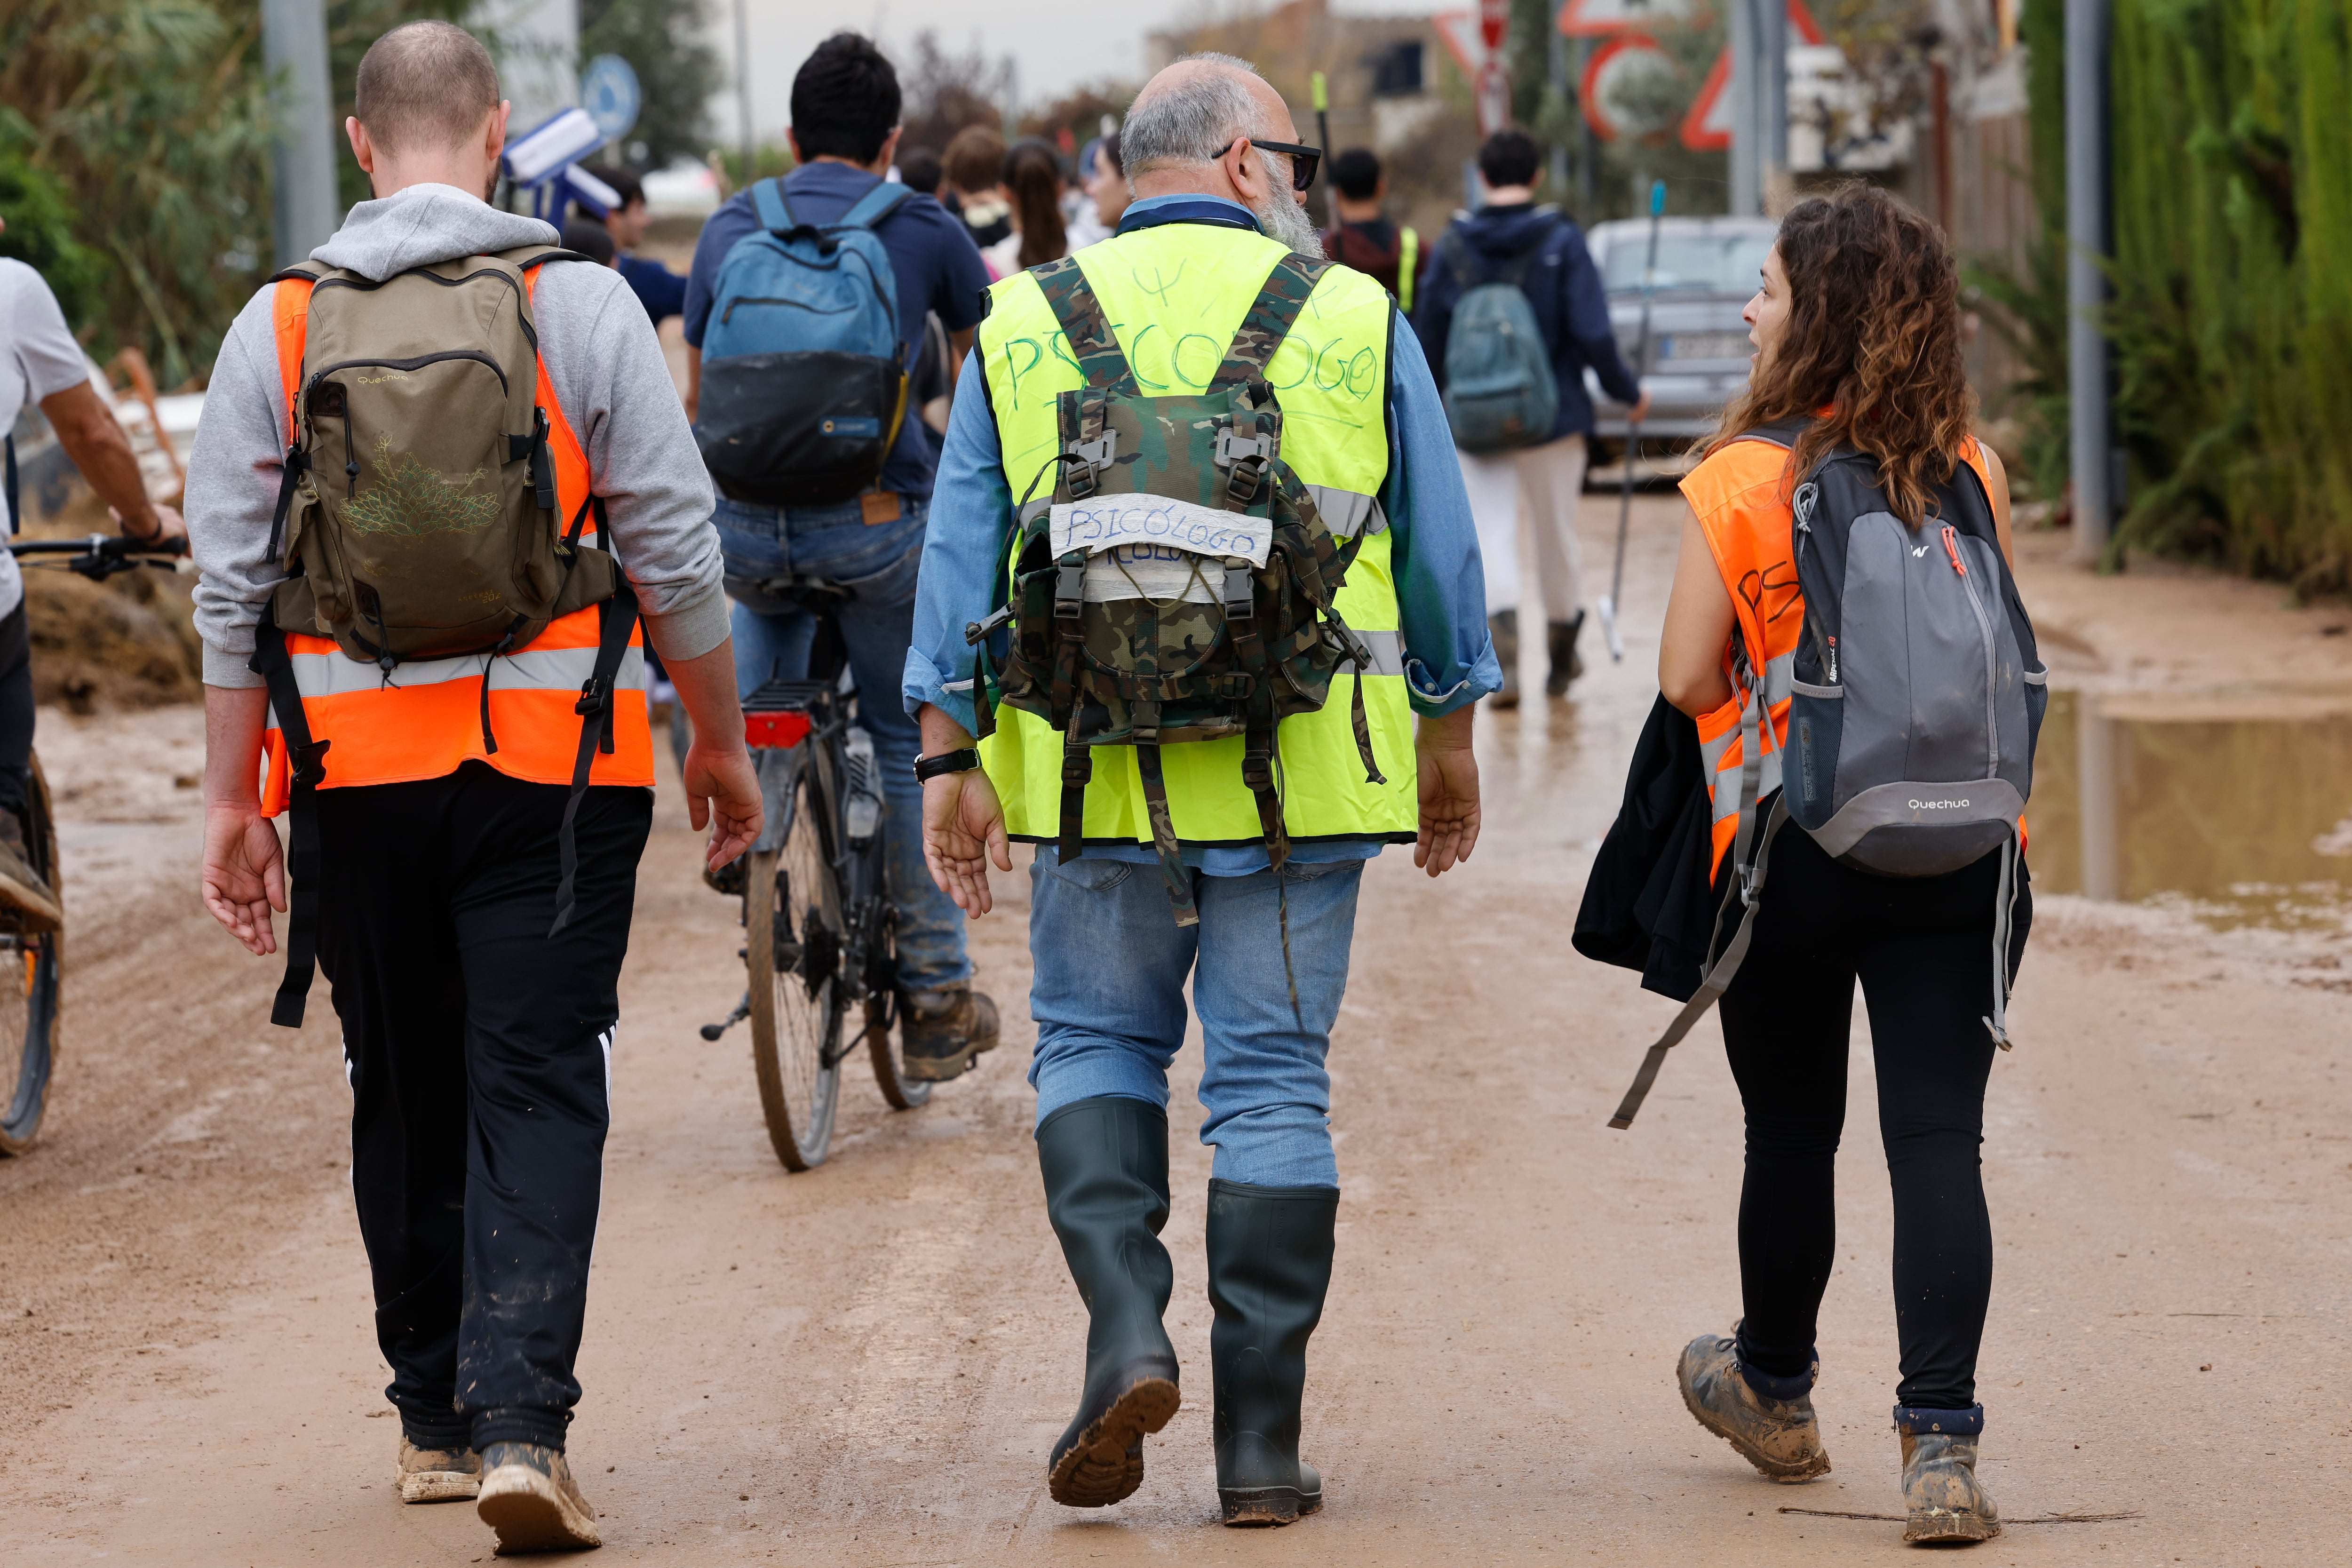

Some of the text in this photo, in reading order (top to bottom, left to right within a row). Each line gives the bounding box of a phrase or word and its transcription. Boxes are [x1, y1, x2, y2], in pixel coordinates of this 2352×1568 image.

[358, 374, 408, 384] Quechua
[1066, 504, 1255, 553] PSICÓLOGO
[1828, 636, 1836, 647] 20
[1908, 799, 1970, 809] Quechua
